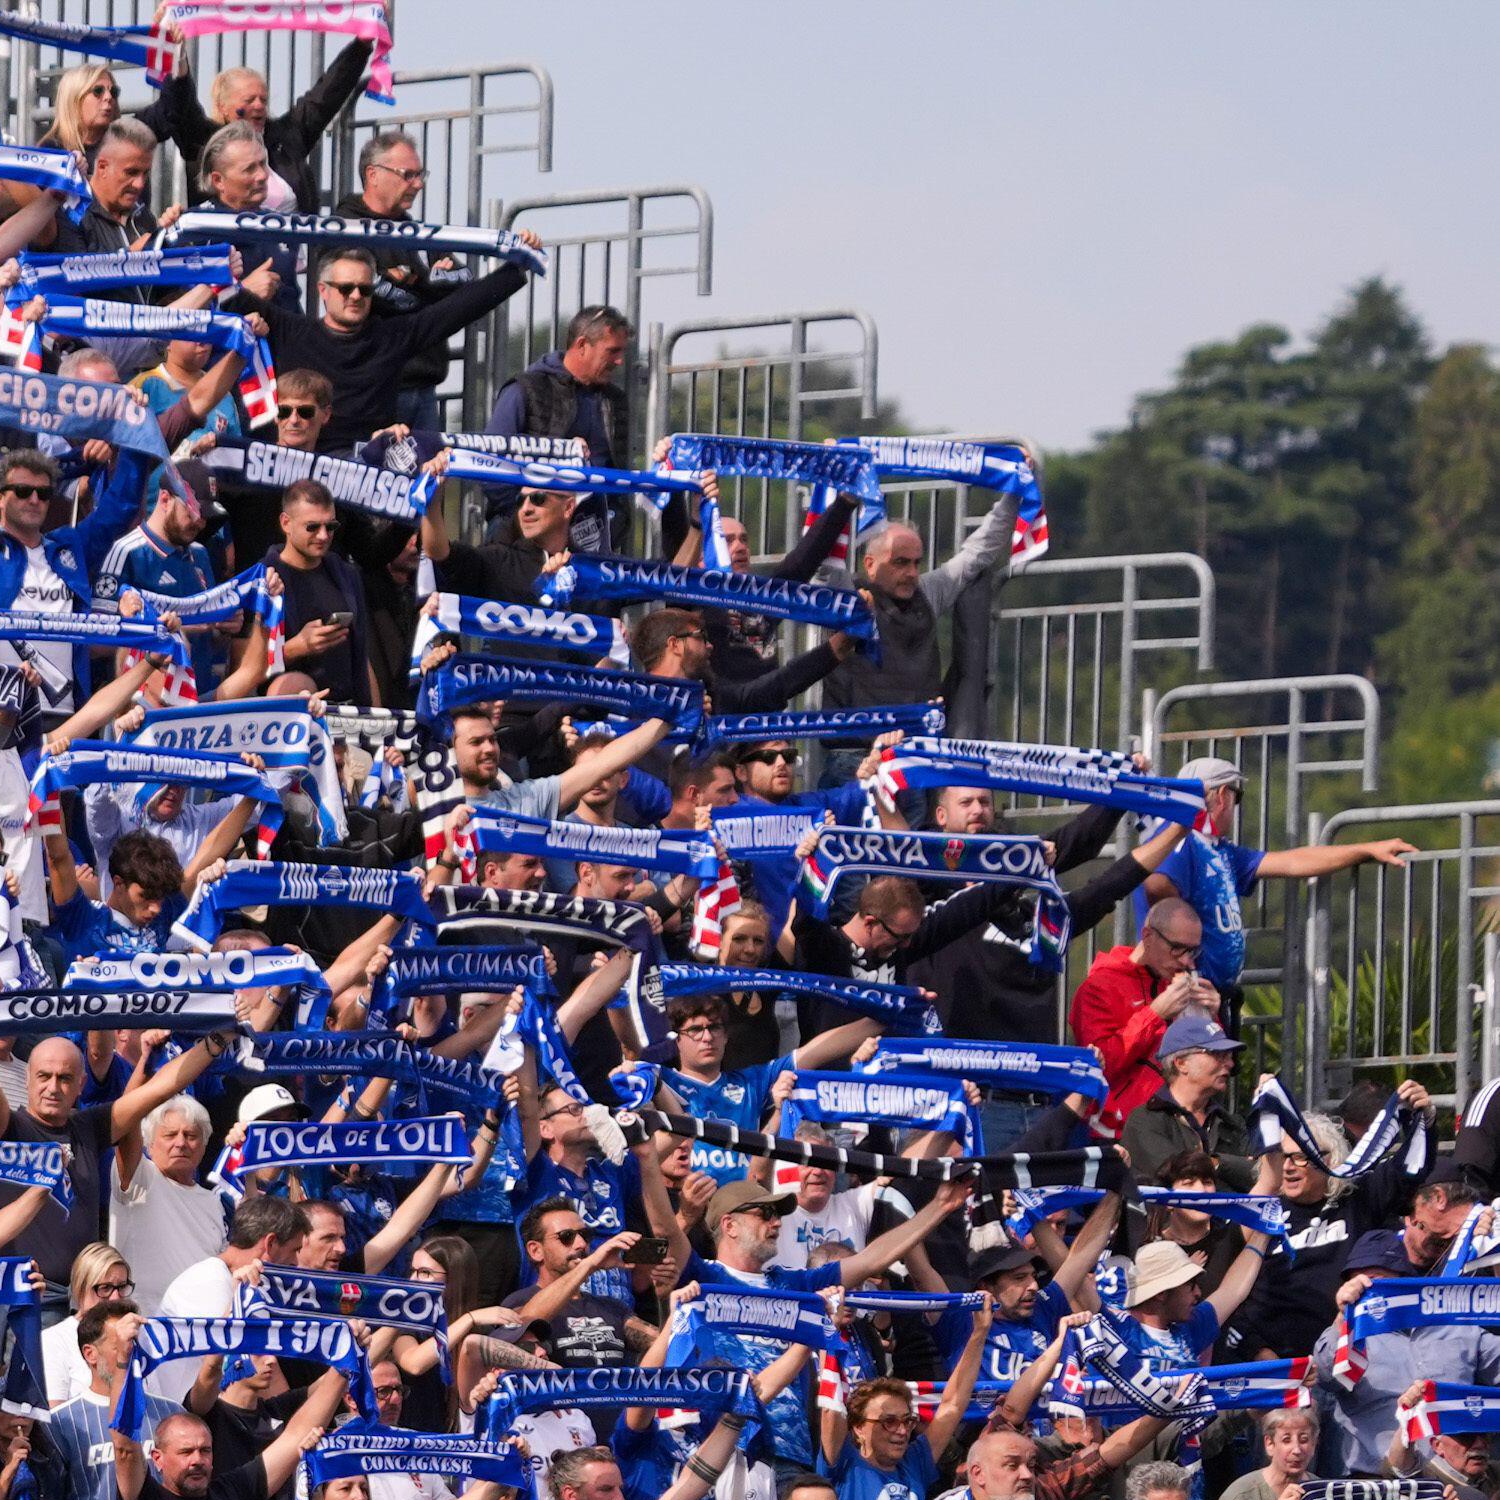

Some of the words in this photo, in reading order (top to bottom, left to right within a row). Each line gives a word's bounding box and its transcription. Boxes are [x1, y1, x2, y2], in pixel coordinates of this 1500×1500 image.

[238, 212, 347, 231] COMO
[359, 219, 442, 239] 1907
[20, 409, 62, 429] 1907
[58, 380, 147, 425] COMO
[245, 442, 319, 491] SEMM
[600, 561, 687, 587] SEMM
[701, 569, 857, 617] CUMASCH
[475, 600, 597, 643] COMO
[453, 664, 534, 688] SEMM
[540, 669, 690, 710] CUMASCH
[819, 831, 928, 864] CURVA
[446, 888, 648, 935] LARIANI
[130, 952, 253, 986] COMO
[9, 995, 104, 1020] COMO
[117, 992, 190, 1014] 1907
[817, 1080, 865, 1115] SEMM
[866, 1085, 949, 1120] CUMASCH
[254, 1121, 334, 1159] ZOCA
[374, 1121, 454, 1154] L'OLI
[690, 1148, 749, 1167] MOLA
[587, 1369, 747, 1394] CUMASCH
[360, 1454, 472, 1473] CONCAGNESE
